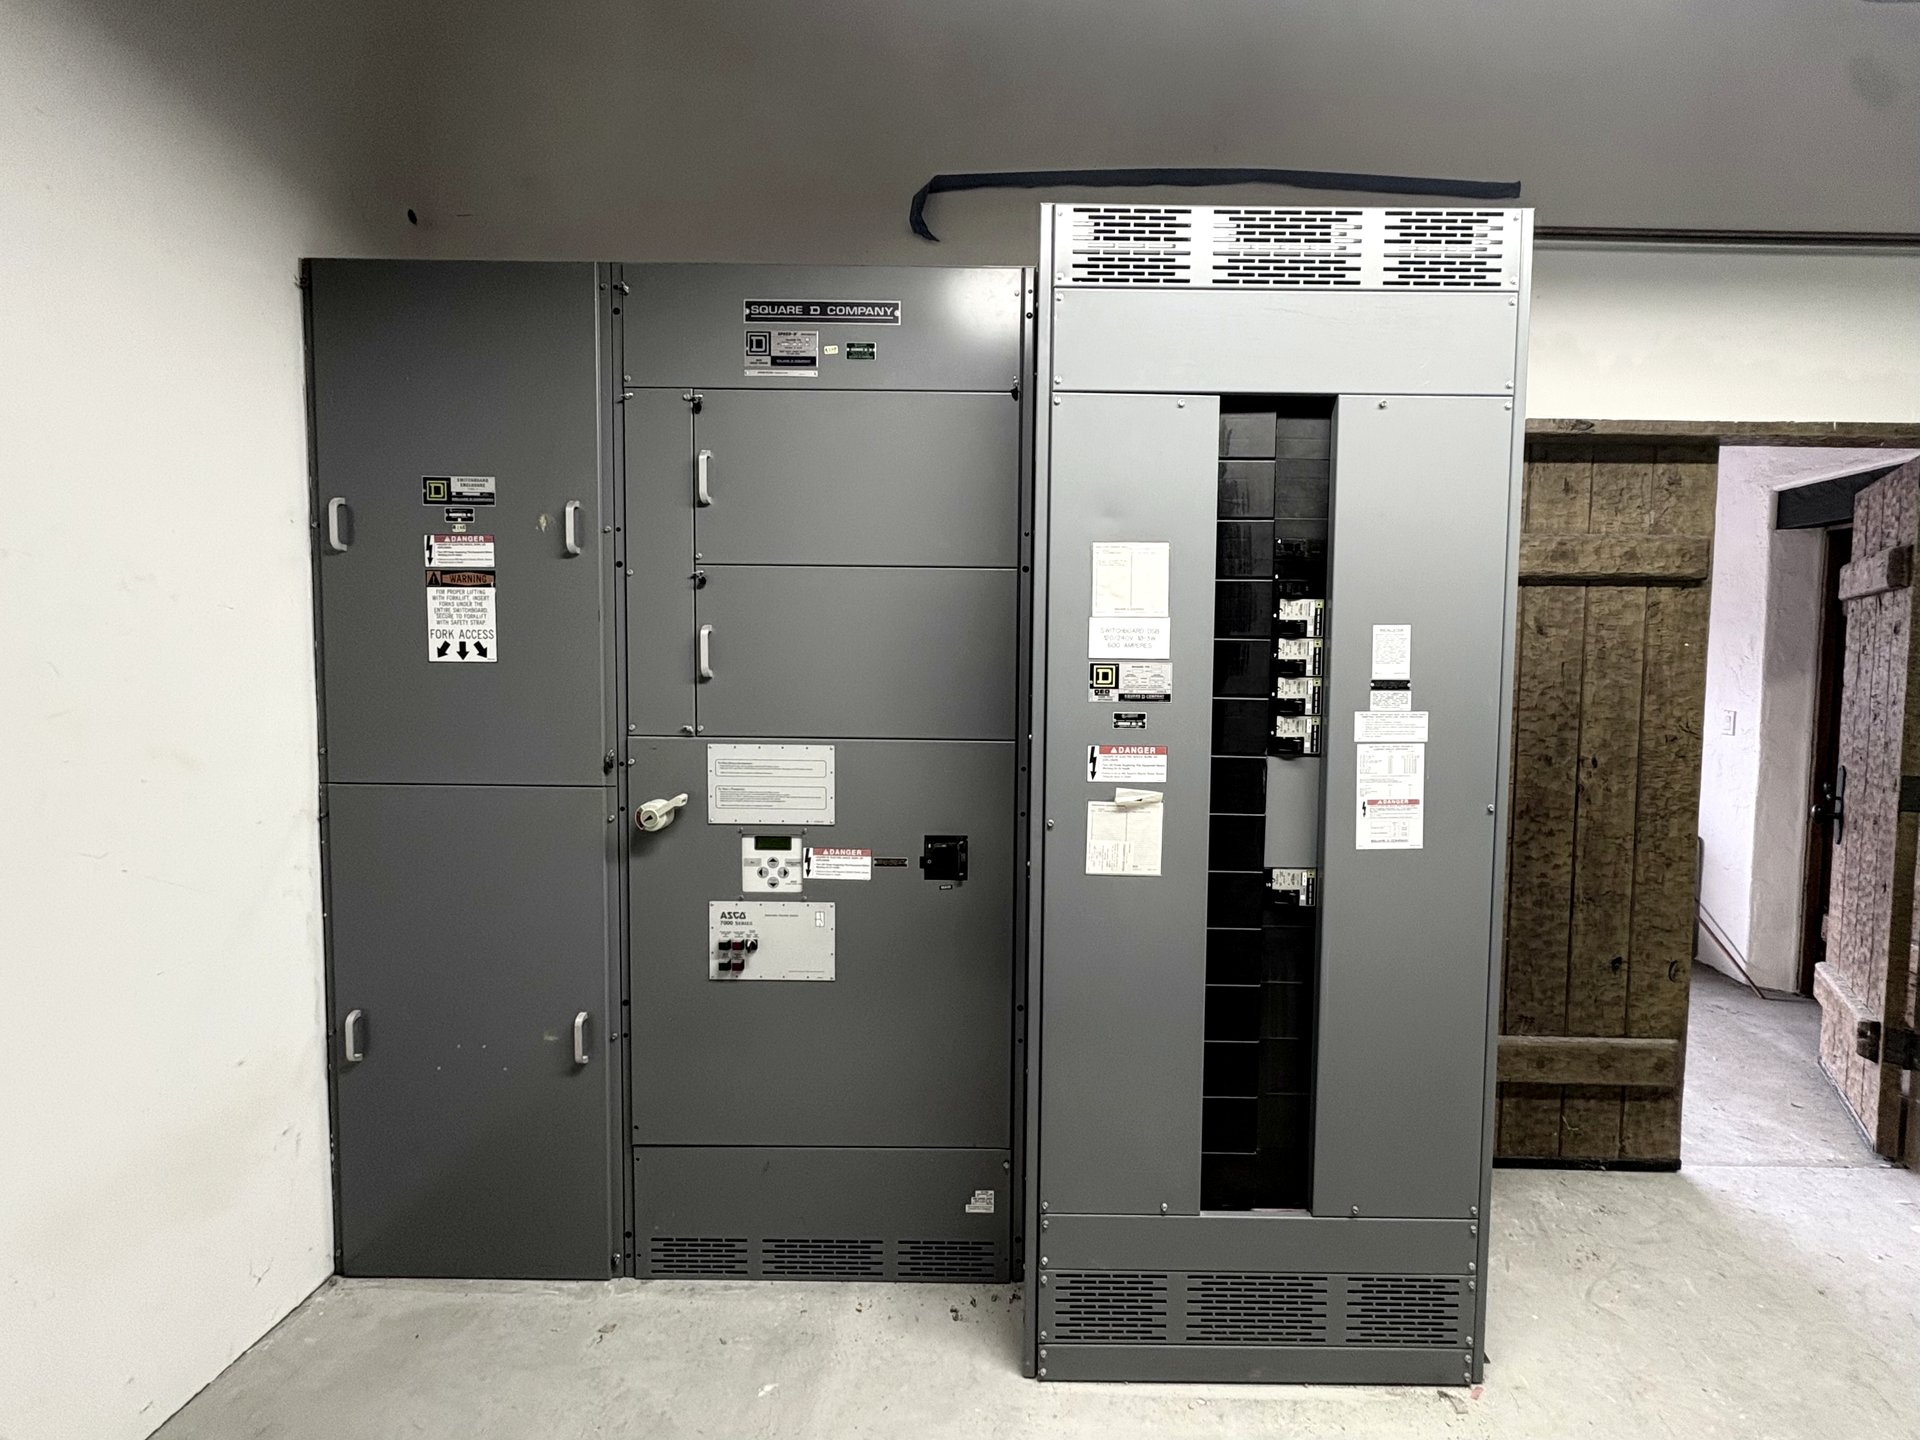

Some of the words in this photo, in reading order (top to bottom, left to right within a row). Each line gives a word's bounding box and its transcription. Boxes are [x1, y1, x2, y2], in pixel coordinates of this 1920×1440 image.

[751, 305, 803, 314] SQUARE
[809, 306, 821, 315] D
[827, 306, 894, 316] COMPANY
[429, 483, 444, 498] D
[449, 574, 487, 583] WARNING
[430, 629, 455, 639] FORK
[458, 629, 495, 639] ACCESS
[1096, 668, 1113, 684] D
[1118, 746, 1157, 754] DANGER
[720, 911, 747, 920] ASCO
